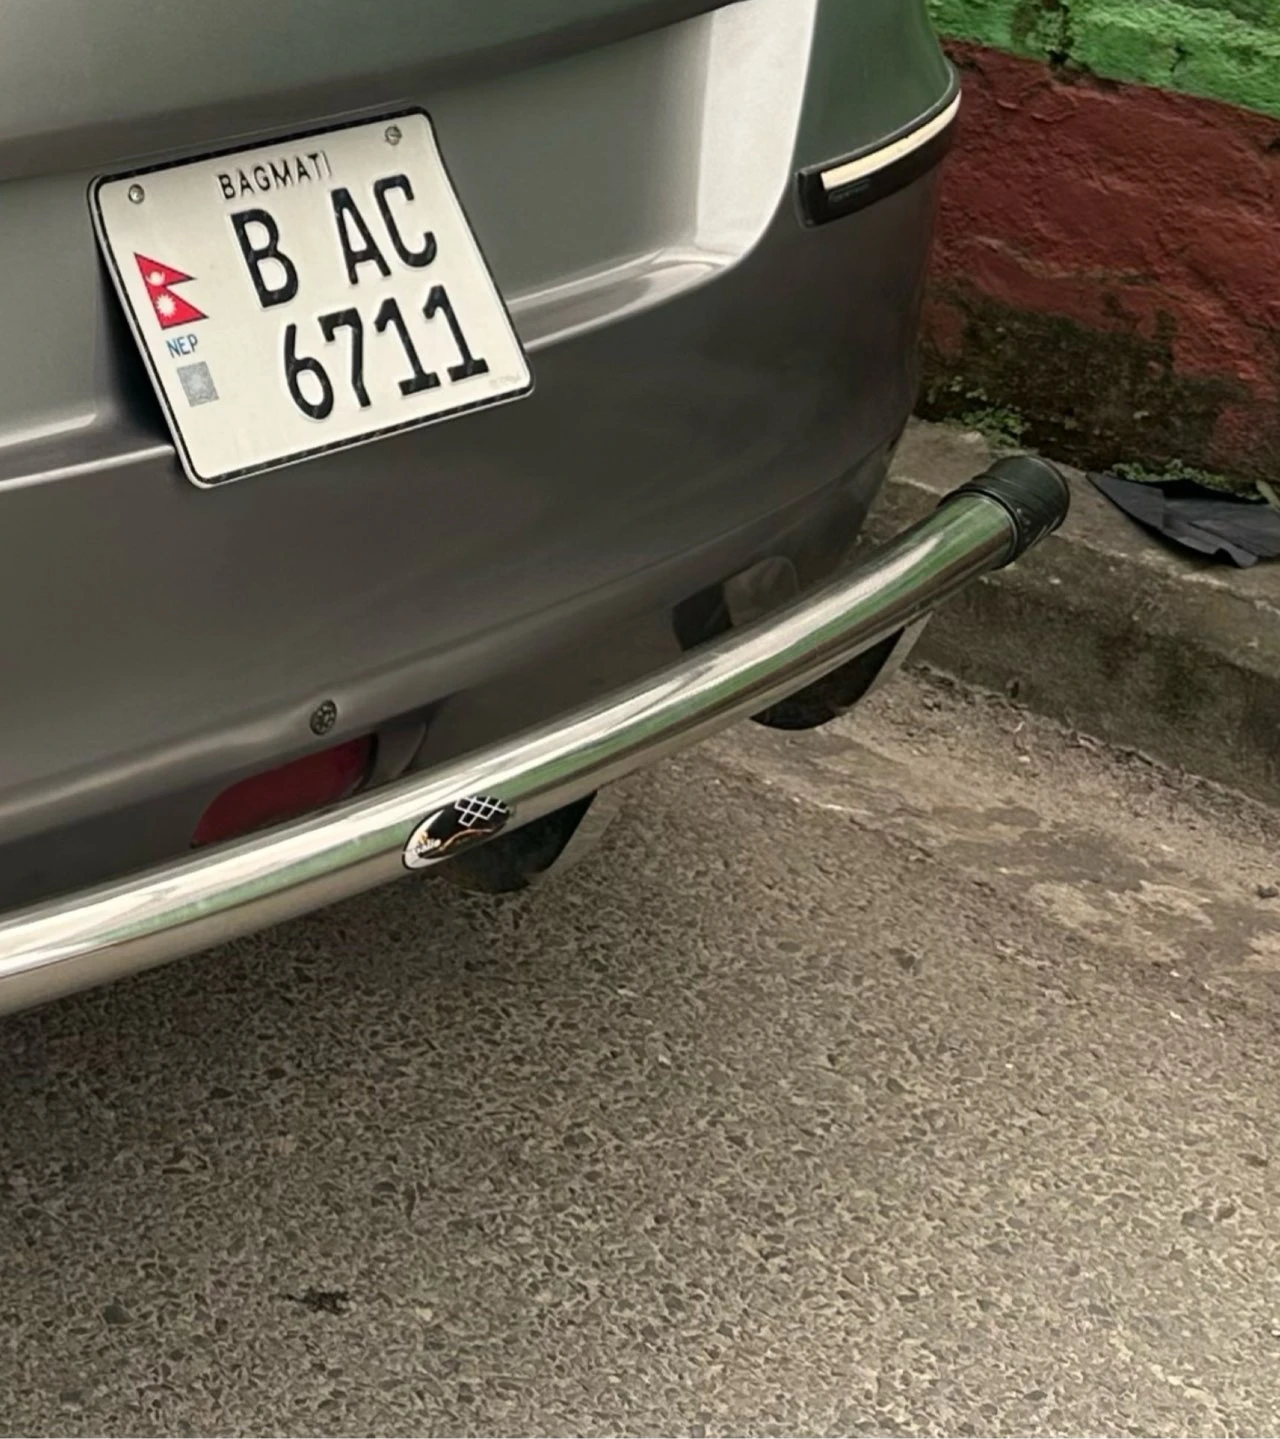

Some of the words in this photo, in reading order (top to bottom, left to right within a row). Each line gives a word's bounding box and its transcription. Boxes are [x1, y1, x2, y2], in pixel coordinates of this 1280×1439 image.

[217, 151, 332, 201] BAGMATI
[230, 208, 299, 308] B
[331, 174, 438, 286] AC
[165, 333, 199, 360] NEP
[283, 285, 490, 421] 6711
